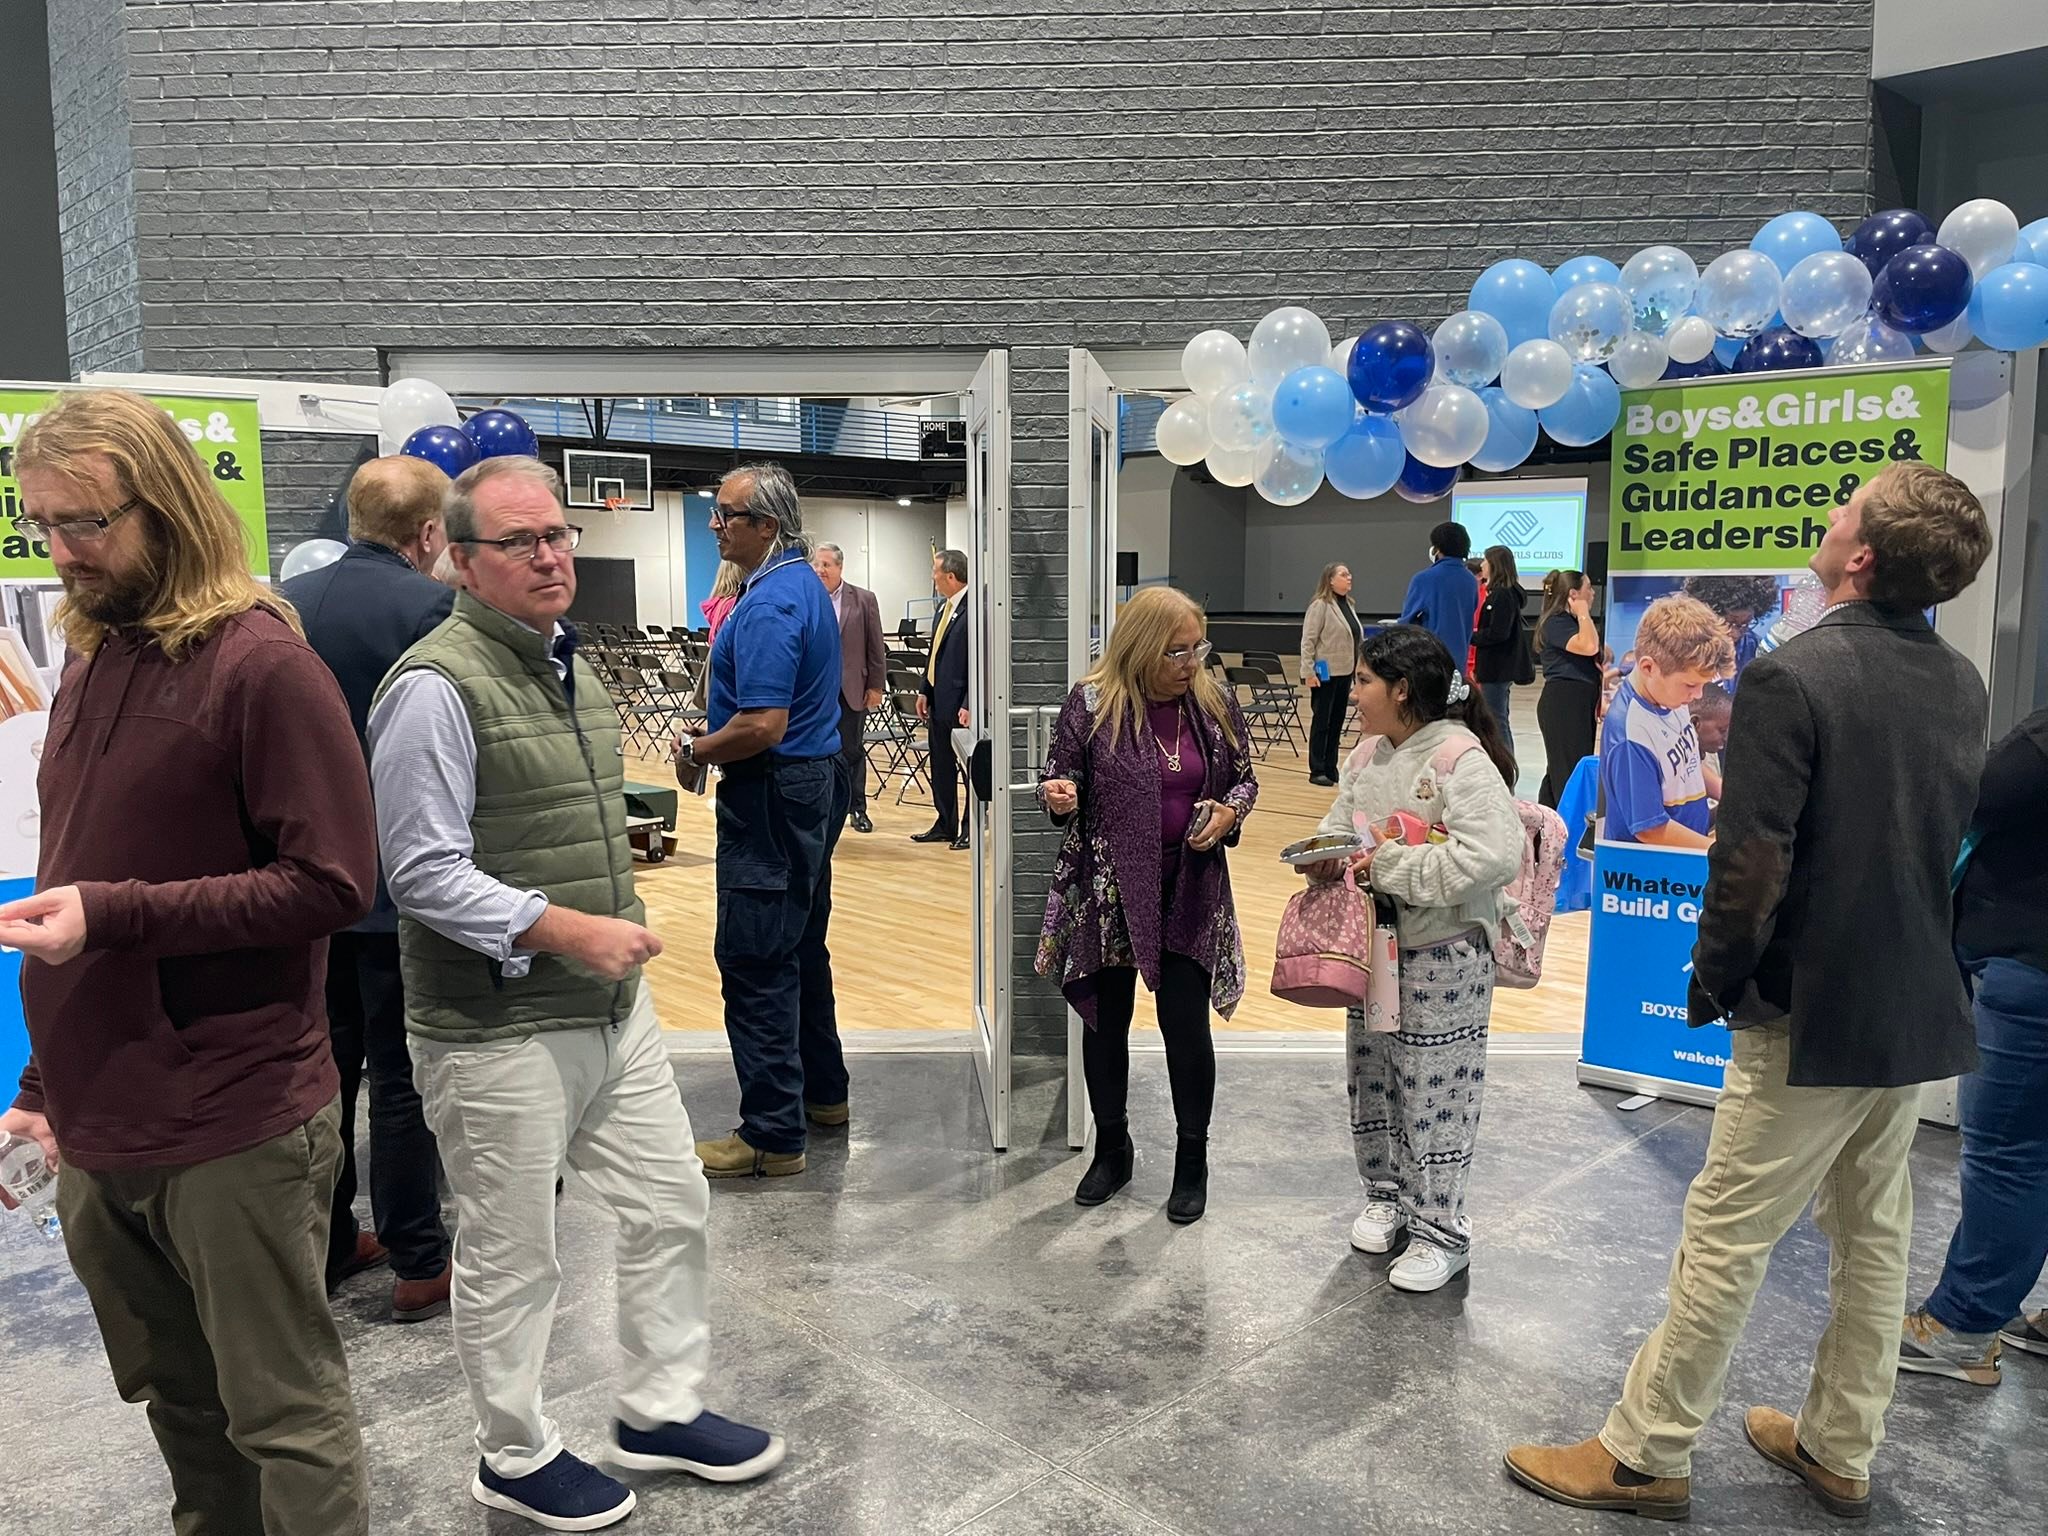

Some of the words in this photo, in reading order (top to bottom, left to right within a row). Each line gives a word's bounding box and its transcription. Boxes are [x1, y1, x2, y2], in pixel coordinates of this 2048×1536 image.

[922, 422, 946, 431] HOME
[1625, 384, 1922, 439] Boys&Girls&
[1622, 441, 1719, 475] Safe
[1728, 428, 1924, 470] Places&
[1621, 473, 1860, 512] Guidance&
[1620, 516, 1827, 551] Leadersh
[1533, 550, 1564, 560] CLUBS
[1602, 869, 1704, 899] Whatev
[1601, 893, 1669, 920] Build
[1640, 1001, 1689, 1020] BOYS
